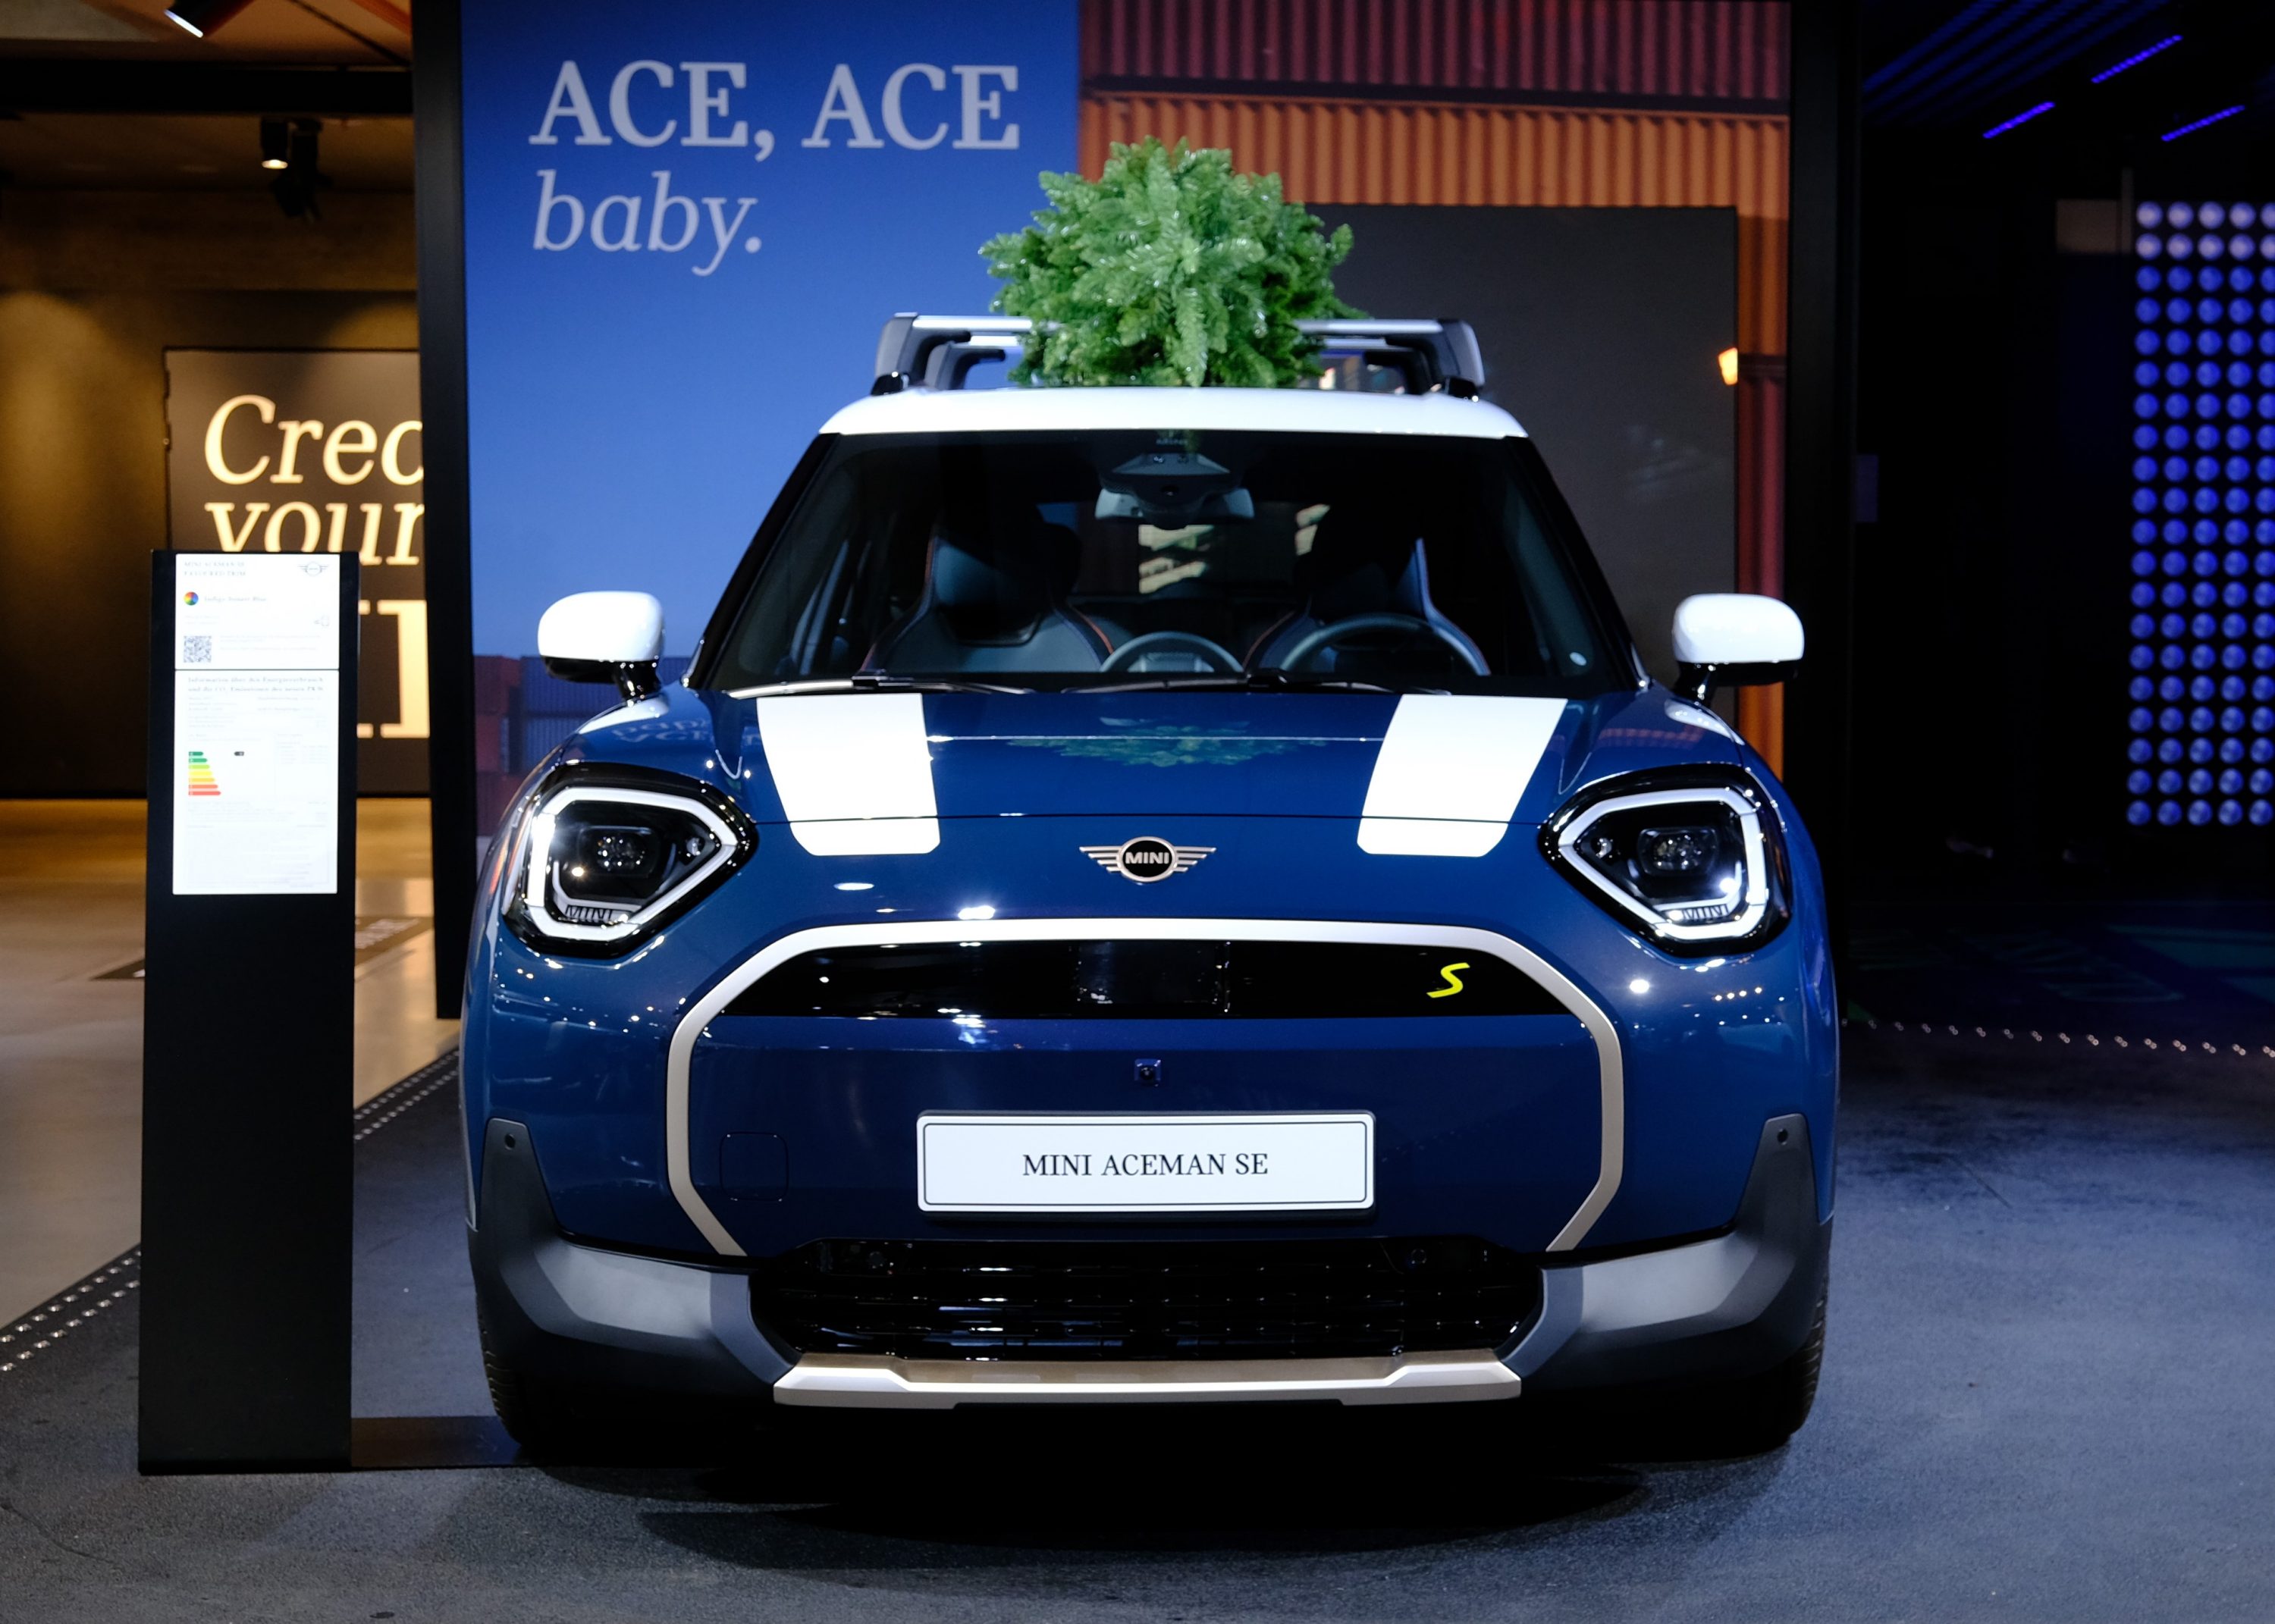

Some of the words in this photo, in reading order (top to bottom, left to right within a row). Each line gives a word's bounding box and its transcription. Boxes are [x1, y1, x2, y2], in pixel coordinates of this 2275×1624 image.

[529, 61, 774, 161] ACE,
[802, 64, 1020, 150] ACE
[532, 169, 762, 277] baby.
[1125, 851, 1170, 864] MINI
[564, 904, 613, 920] MINI
[1426, 961, 1470, 999] S
[1021, 1153, 1093, 1177] MINI
[1101, 1153, 1227, 1176] ACEMAN
[1235, 1153, 1268, 1175] SE
